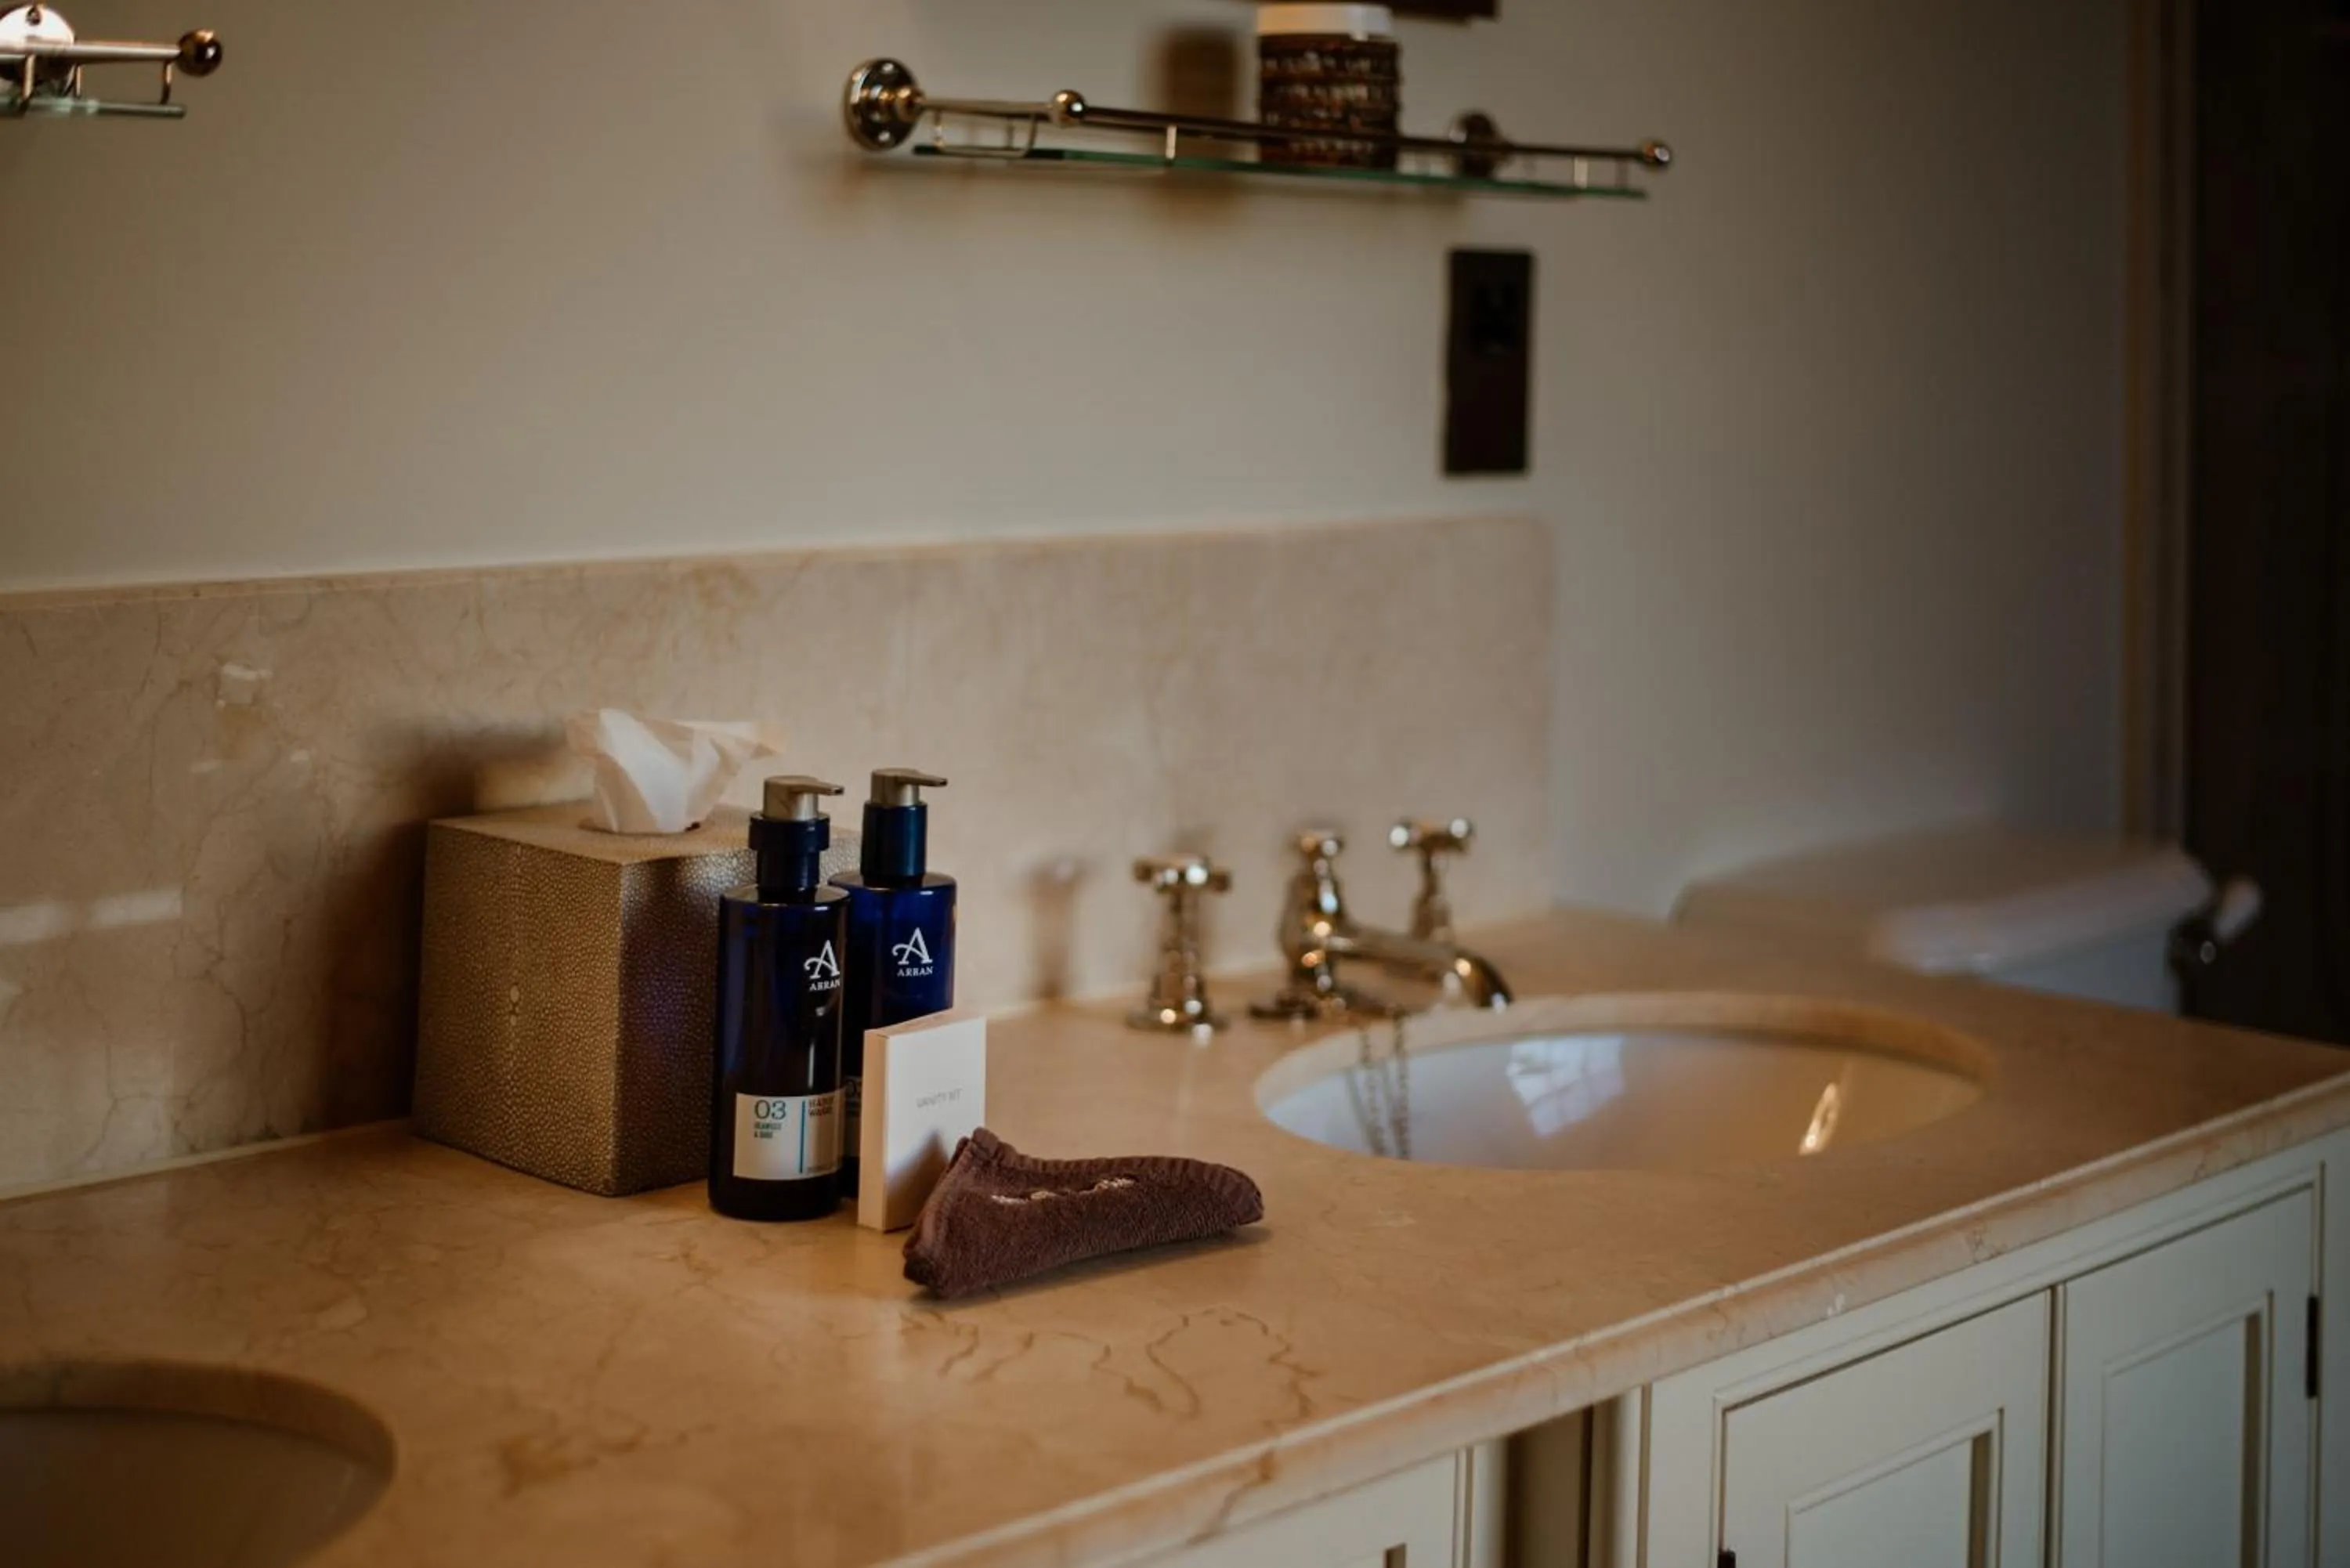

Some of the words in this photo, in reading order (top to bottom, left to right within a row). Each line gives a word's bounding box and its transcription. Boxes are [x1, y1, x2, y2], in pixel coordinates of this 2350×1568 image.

[896, 966, 934, 977] ARRAN
[808, 979, 841, 992] ARRAN
[754, 1099, 786, 1120] 03
